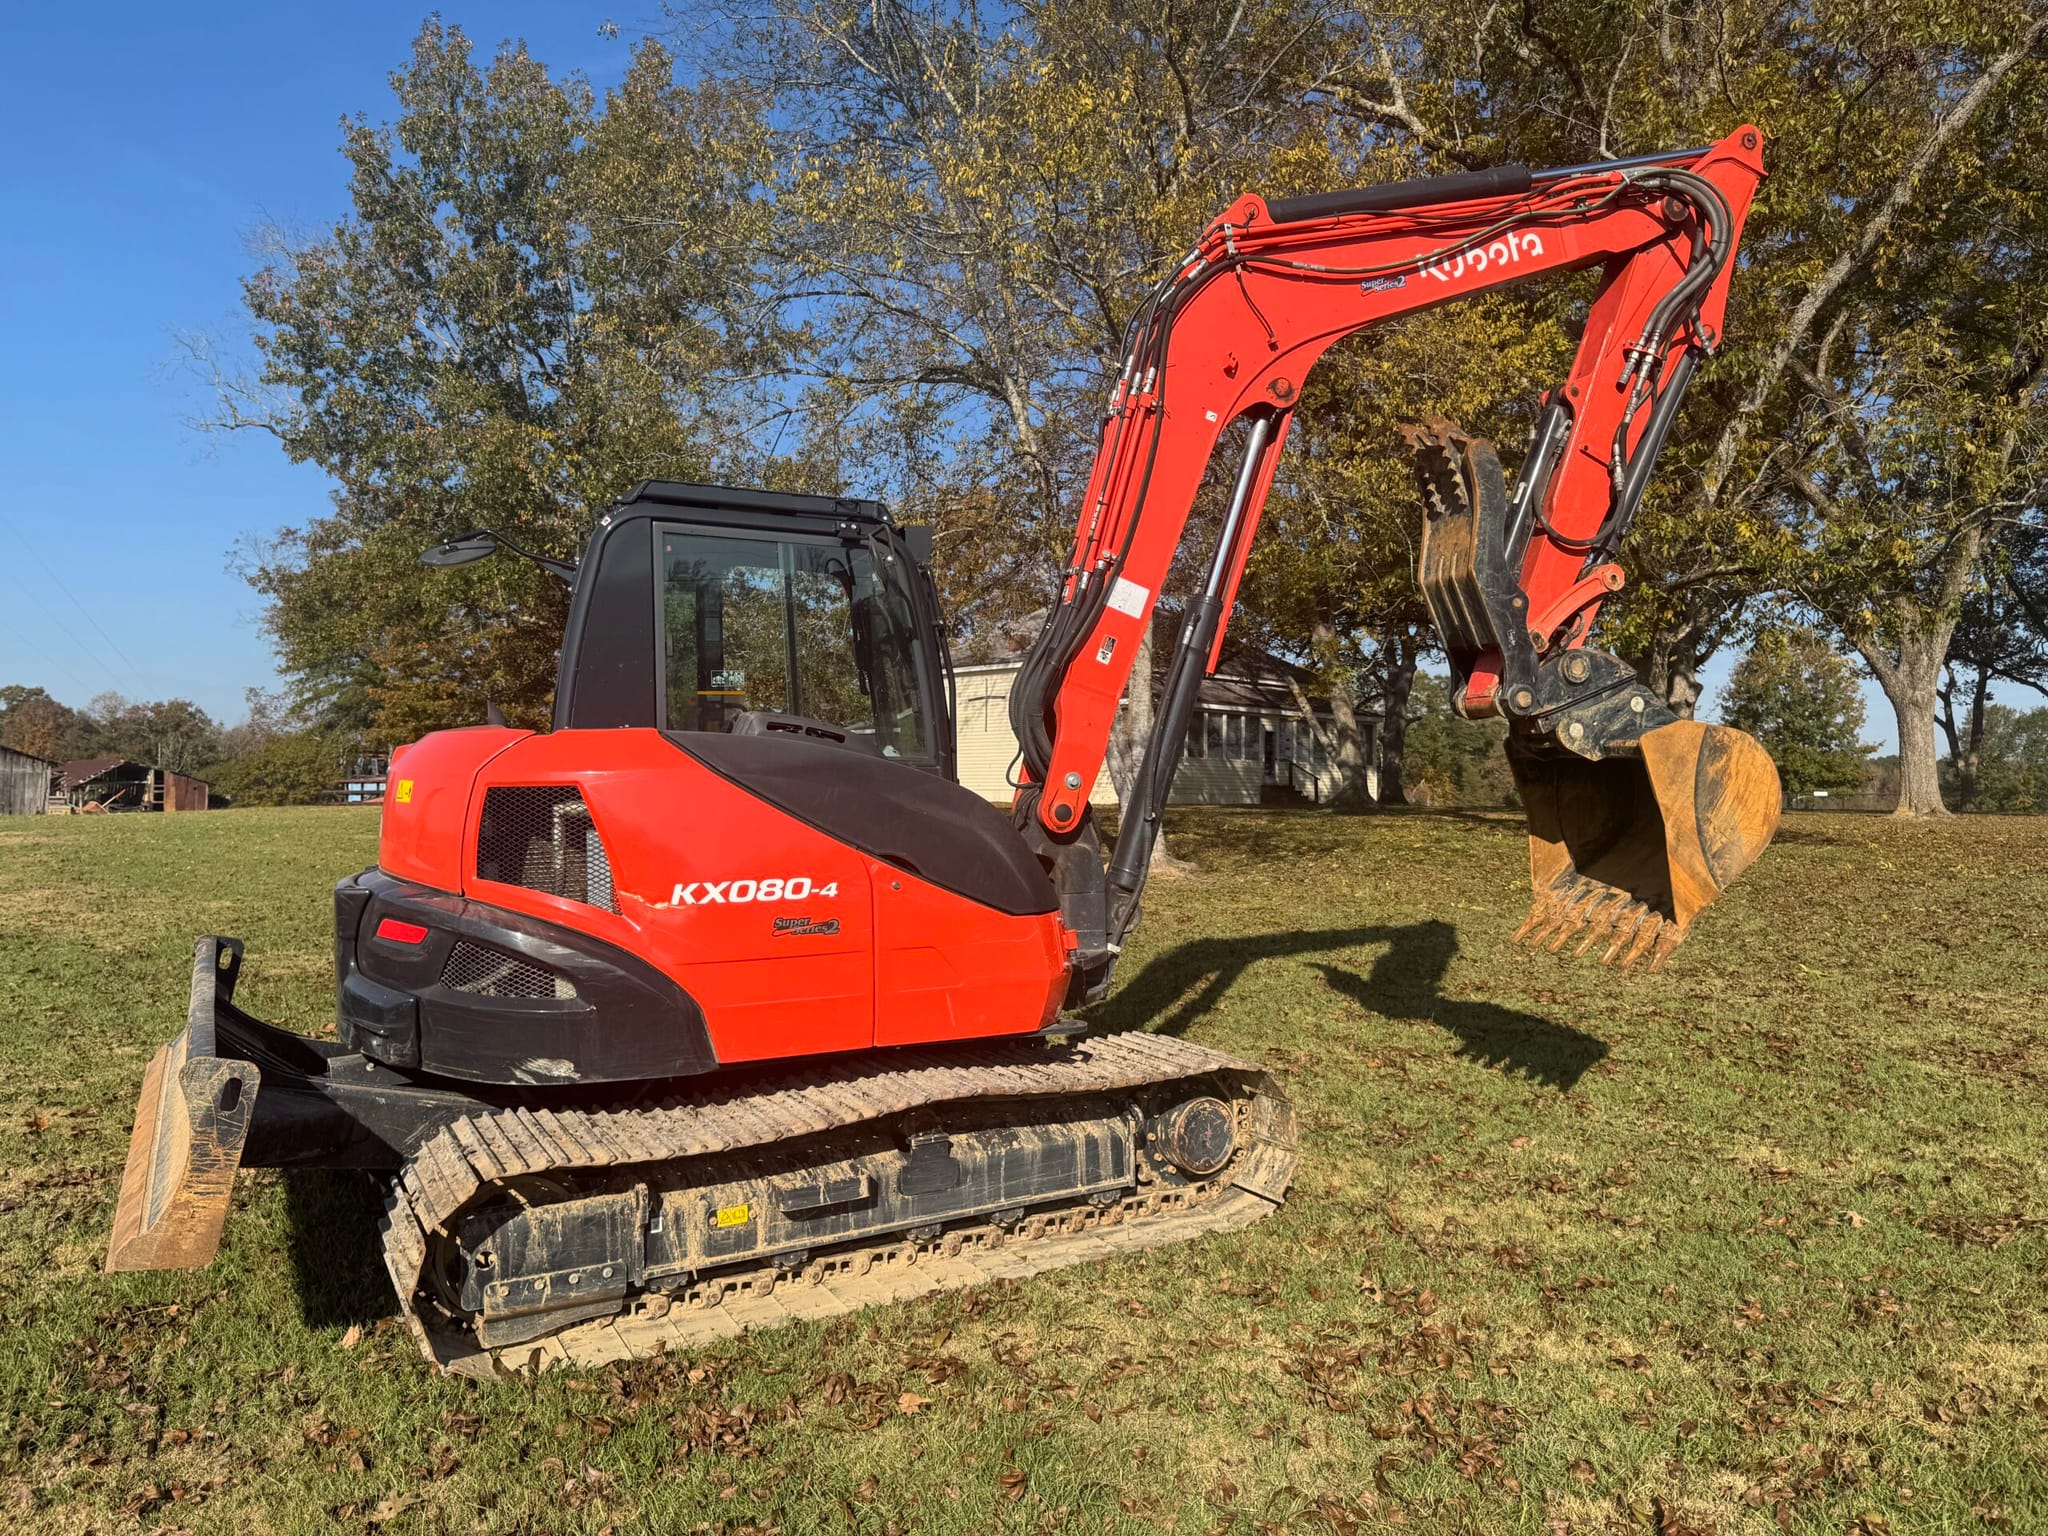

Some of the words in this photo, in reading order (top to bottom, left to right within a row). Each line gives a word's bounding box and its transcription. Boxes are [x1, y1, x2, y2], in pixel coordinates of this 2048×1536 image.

[1415, 229, 1544, 282] Kubota
[1361, 277, 1385, 290] Super
[671, 877, 838, 905] KX080-4
[775, 918, 810, 929] Super
